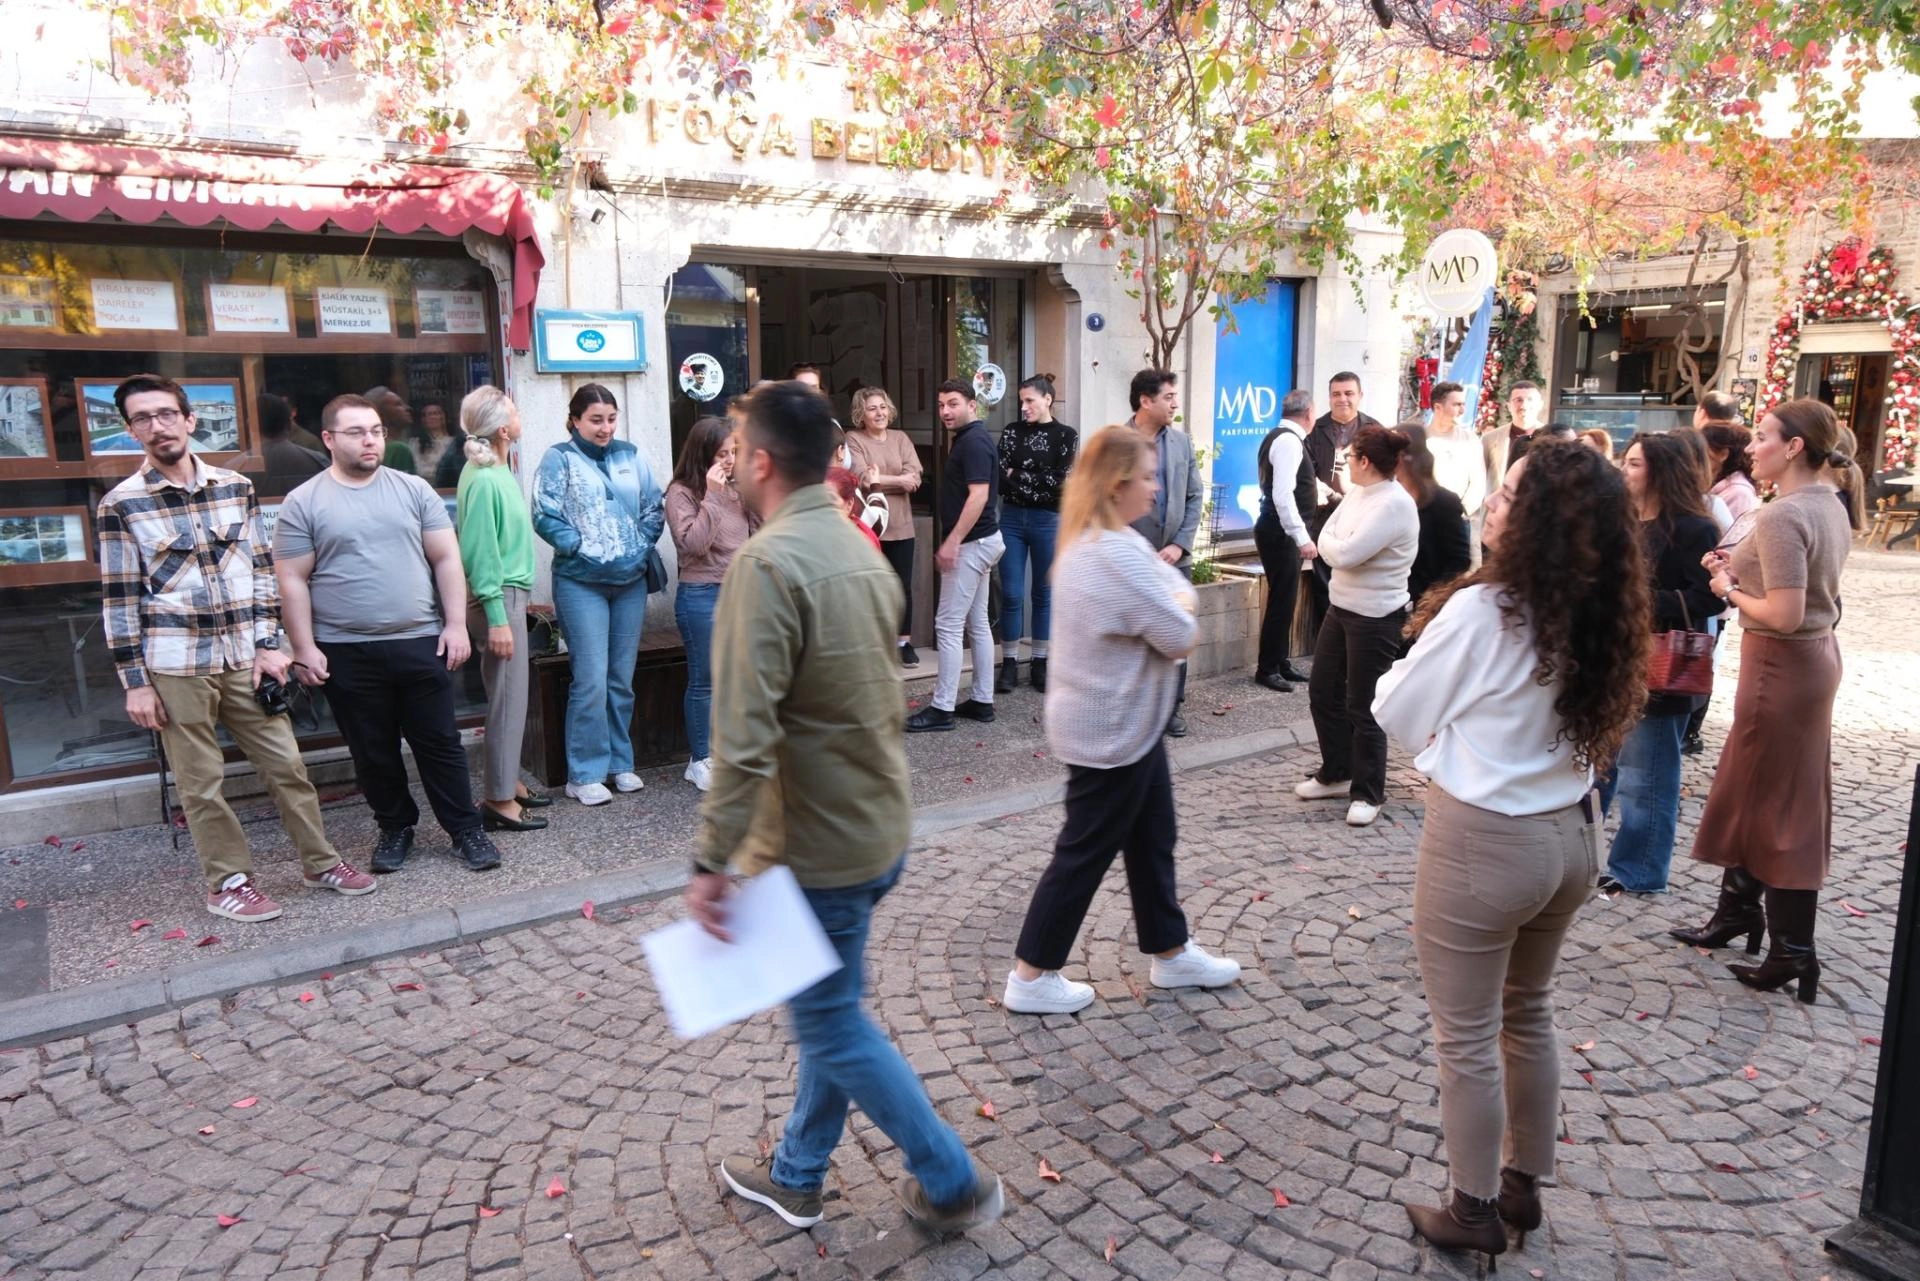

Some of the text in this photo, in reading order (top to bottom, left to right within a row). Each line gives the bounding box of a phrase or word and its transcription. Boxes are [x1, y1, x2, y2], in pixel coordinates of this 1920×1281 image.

[1428, 254, 1479, 285] MAD
[215, 304, 255, 313] VERASET
[1748, 354, 1758, 363] 10
[1216, 381, 1276, 424] MAD
